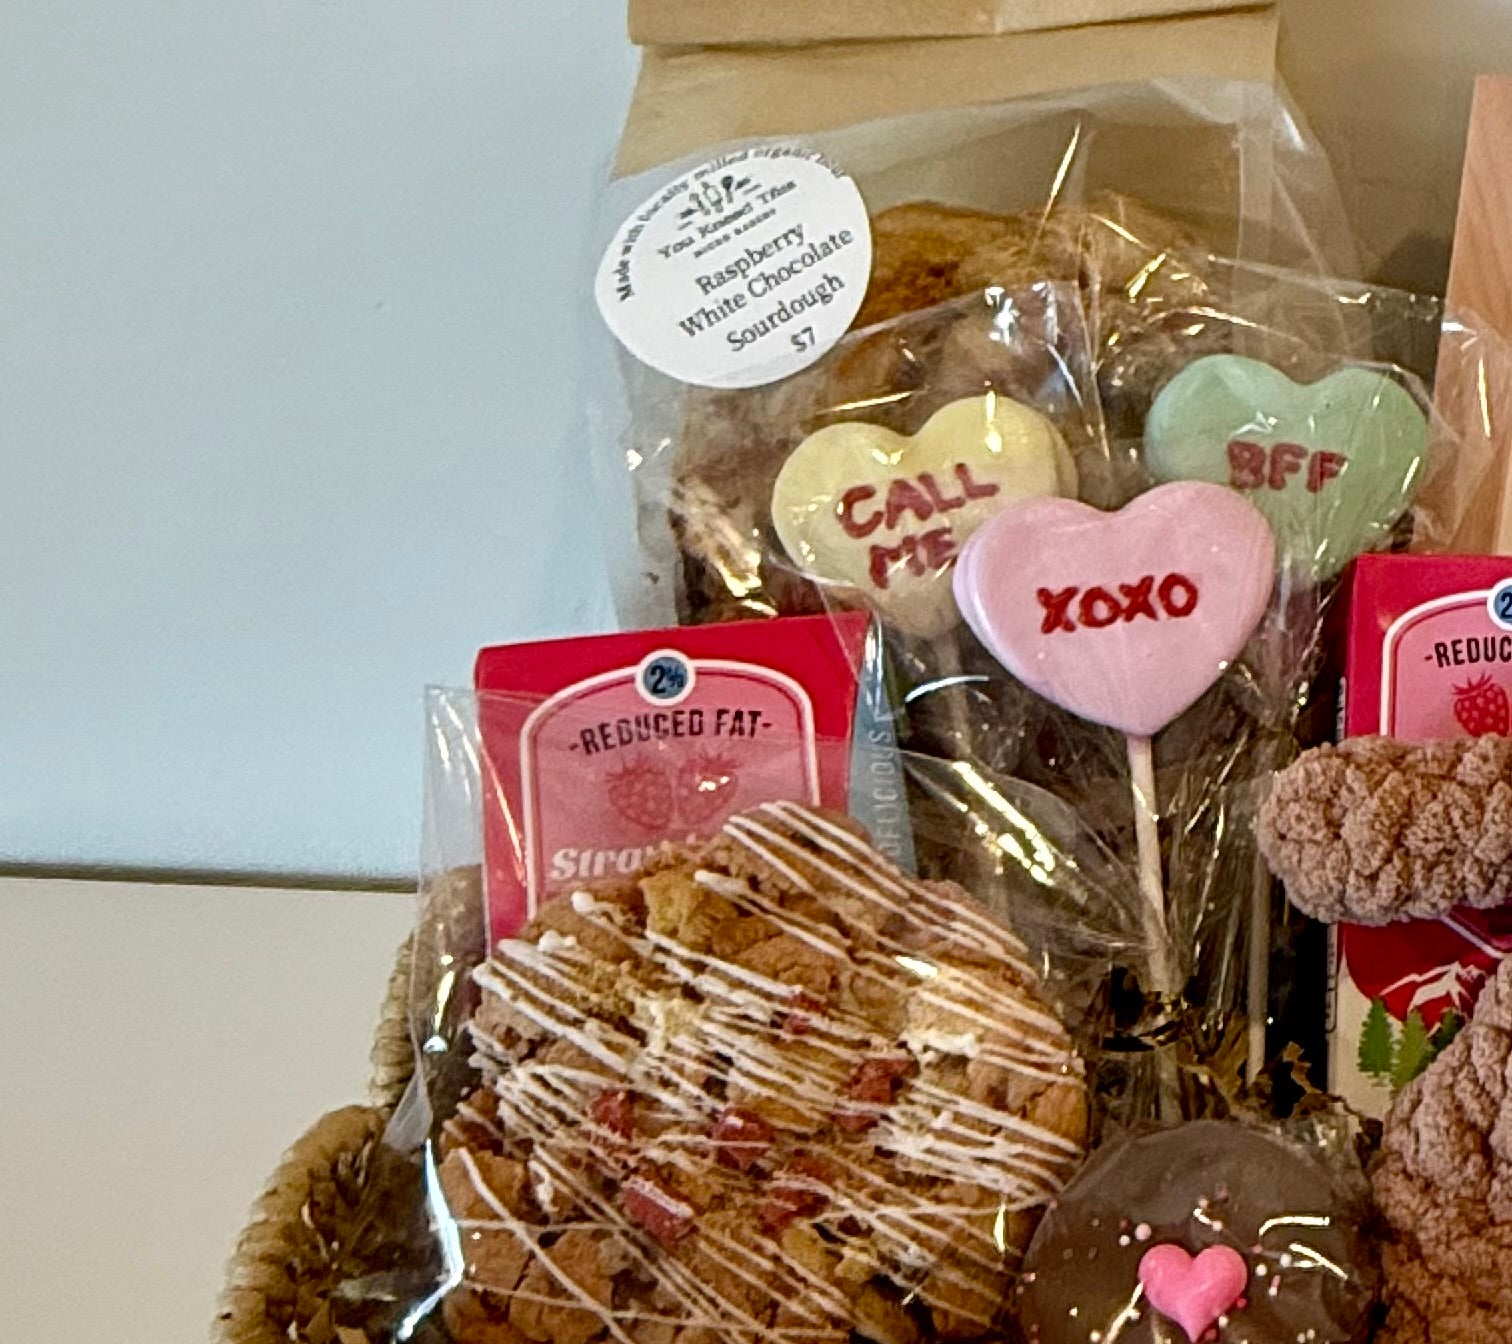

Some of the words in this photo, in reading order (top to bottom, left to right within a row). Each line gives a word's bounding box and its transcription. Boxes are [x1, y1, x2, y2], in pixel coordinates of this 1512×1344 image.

[656, 236, 695, 258] You
[695, 222, 804, 296] Raspberry
[678, 290, 749, 338] White
[746, 227, 855, 299] Chocolate
[726, 272, 847, 353] Sourdough
[789, 326, 819, 353] $7
[1227, 440, 1350, 494] BFF
[836, 462, 1001, 539] CALL
[868, 527, 958, 590] ME
[1037, 571, 1199, 635] XOXO
[650, 664, 685, 694] 2%
